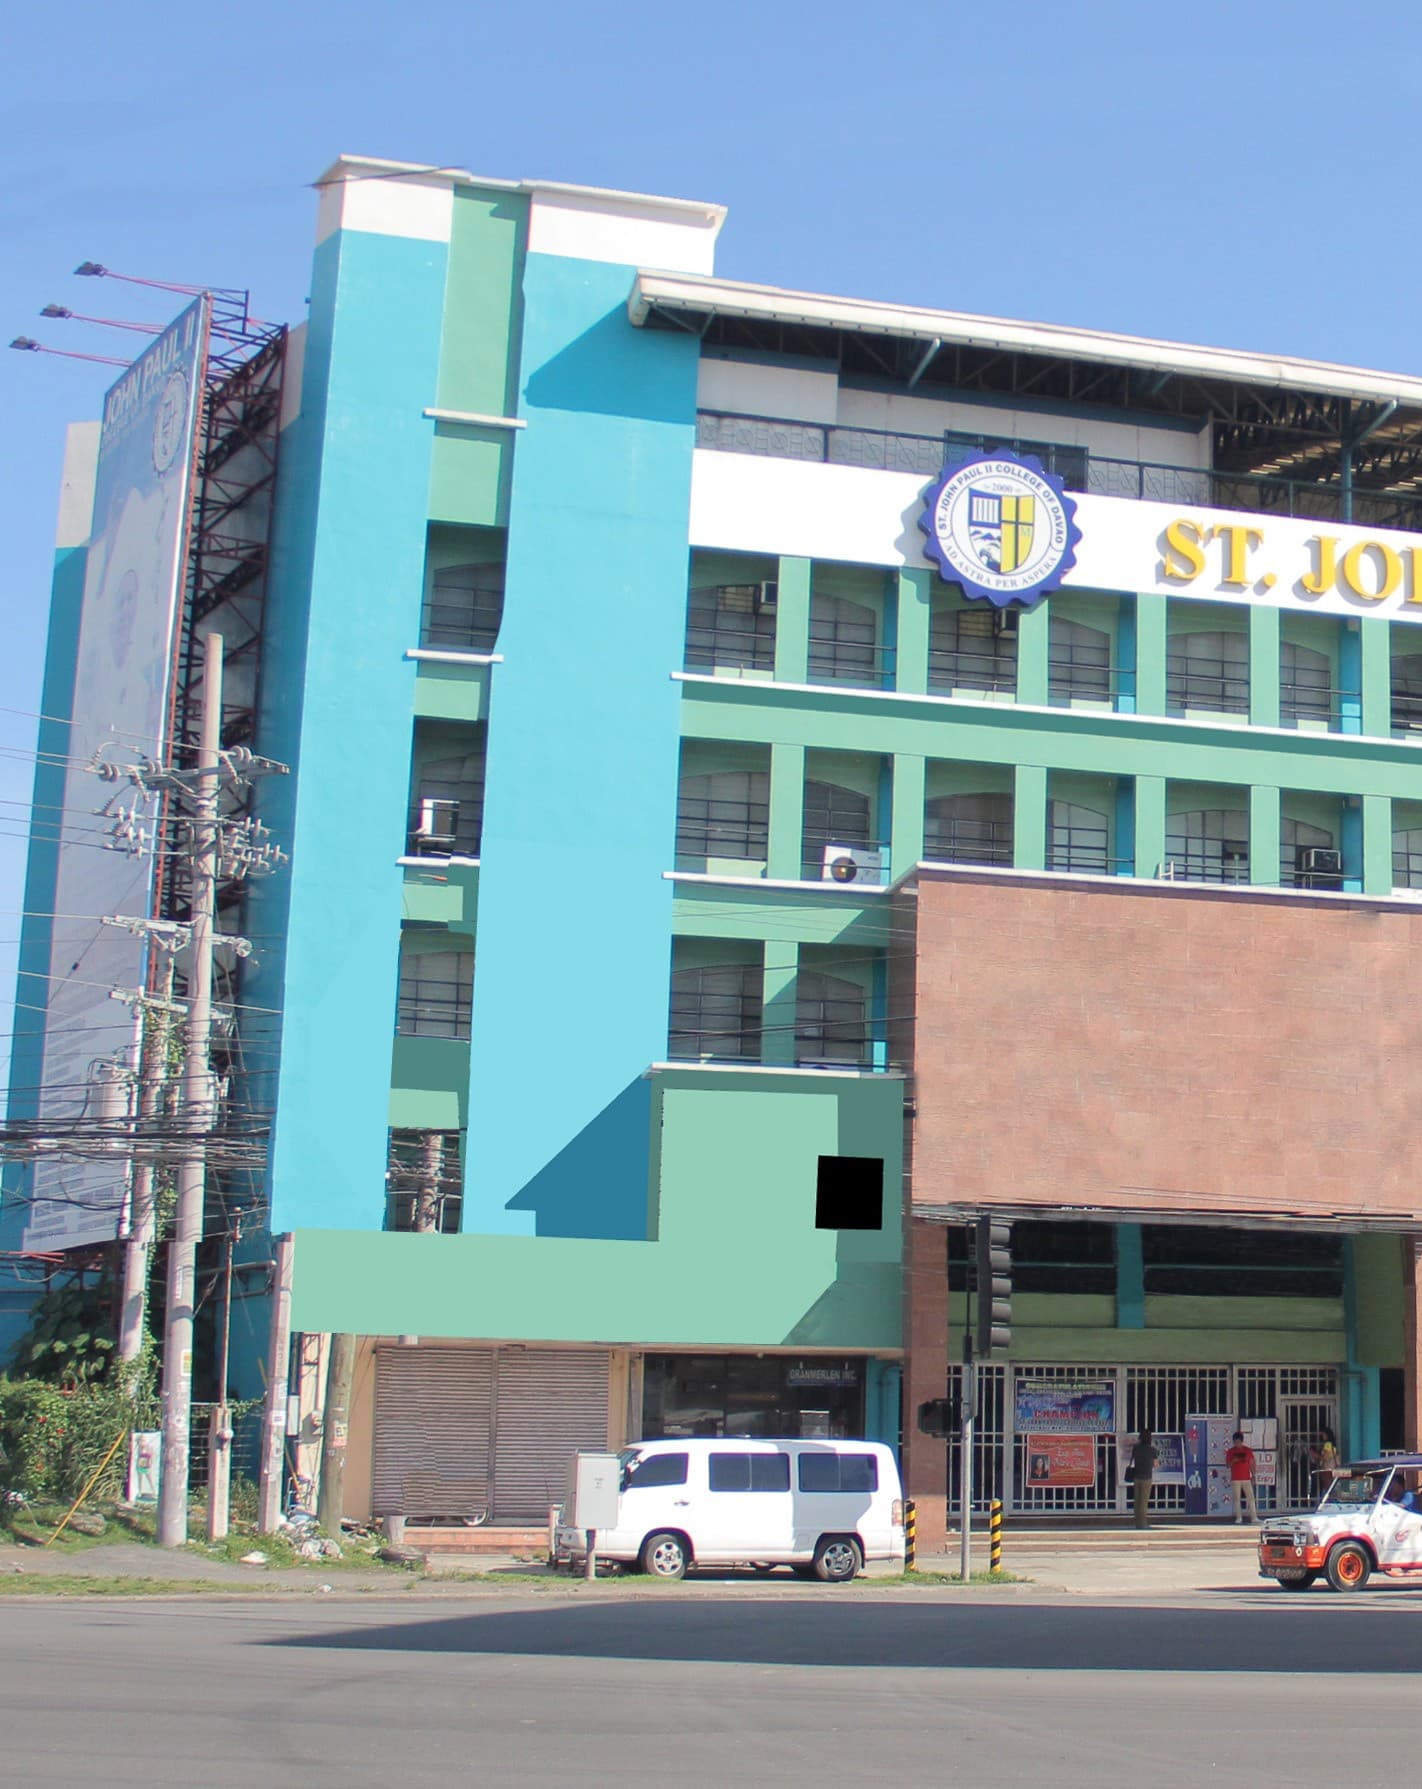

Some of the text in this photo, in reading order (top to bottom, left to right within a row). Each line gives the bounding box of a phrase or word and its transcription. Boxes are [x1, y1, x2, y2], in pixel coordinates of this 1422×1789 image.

[143, 328, 180, 388] PAUL
[184, 311, 196, 351] II
[942, 484, 959, 512] JOHN
[957, 467, 982, 485] PAUL
[985, 464, 992, 473] II
[995, 463, 1043, 492] COLLEGE
[1042, 490, 1057, 502] OF
[1050, 506, 1064, 544] DAVAO
[995, 578, 1018, 588] PER
[1164, 518, 1278, 588] ST.
